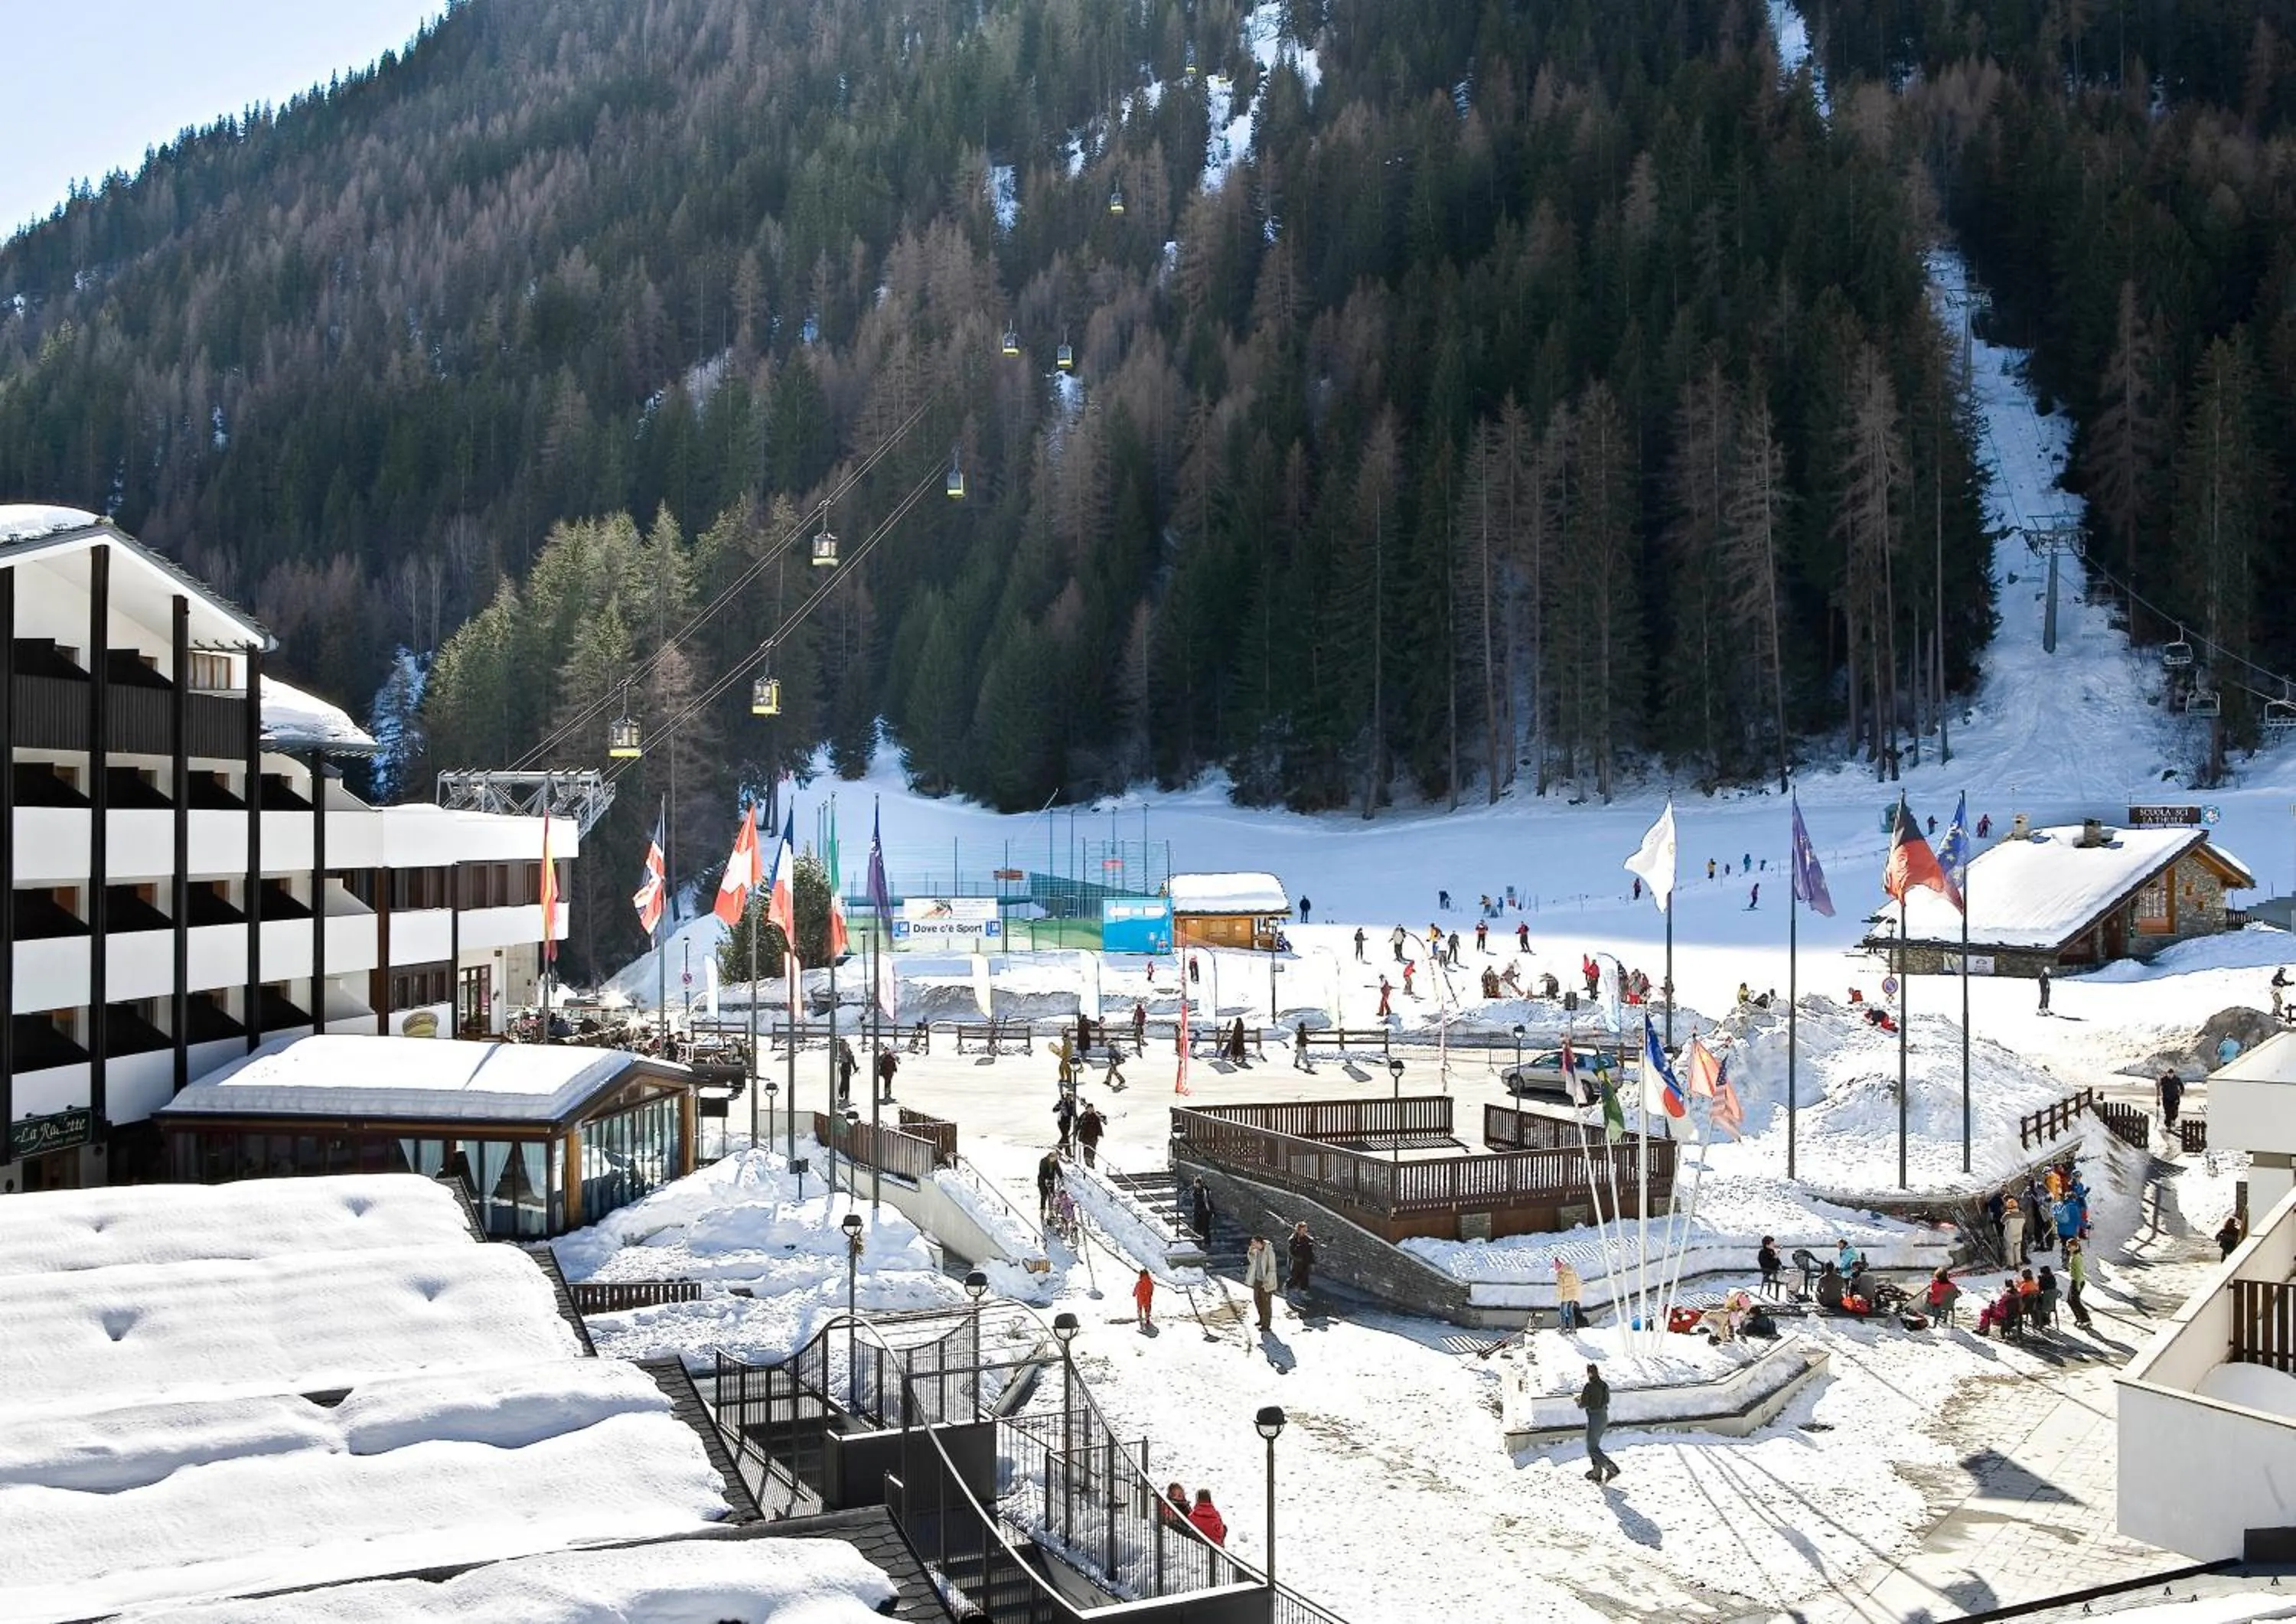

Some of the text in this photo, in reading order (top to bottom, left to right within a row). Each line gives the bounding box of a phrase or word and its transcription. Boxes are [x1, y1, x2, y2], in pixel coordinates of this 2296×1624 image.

[2139, 808, 2188, 817] SCUOLA SCI
[913, 924, 938, 933] Dove
[956, 924, 983, 934] Sport
[15, 1127, 37, 1143] La
